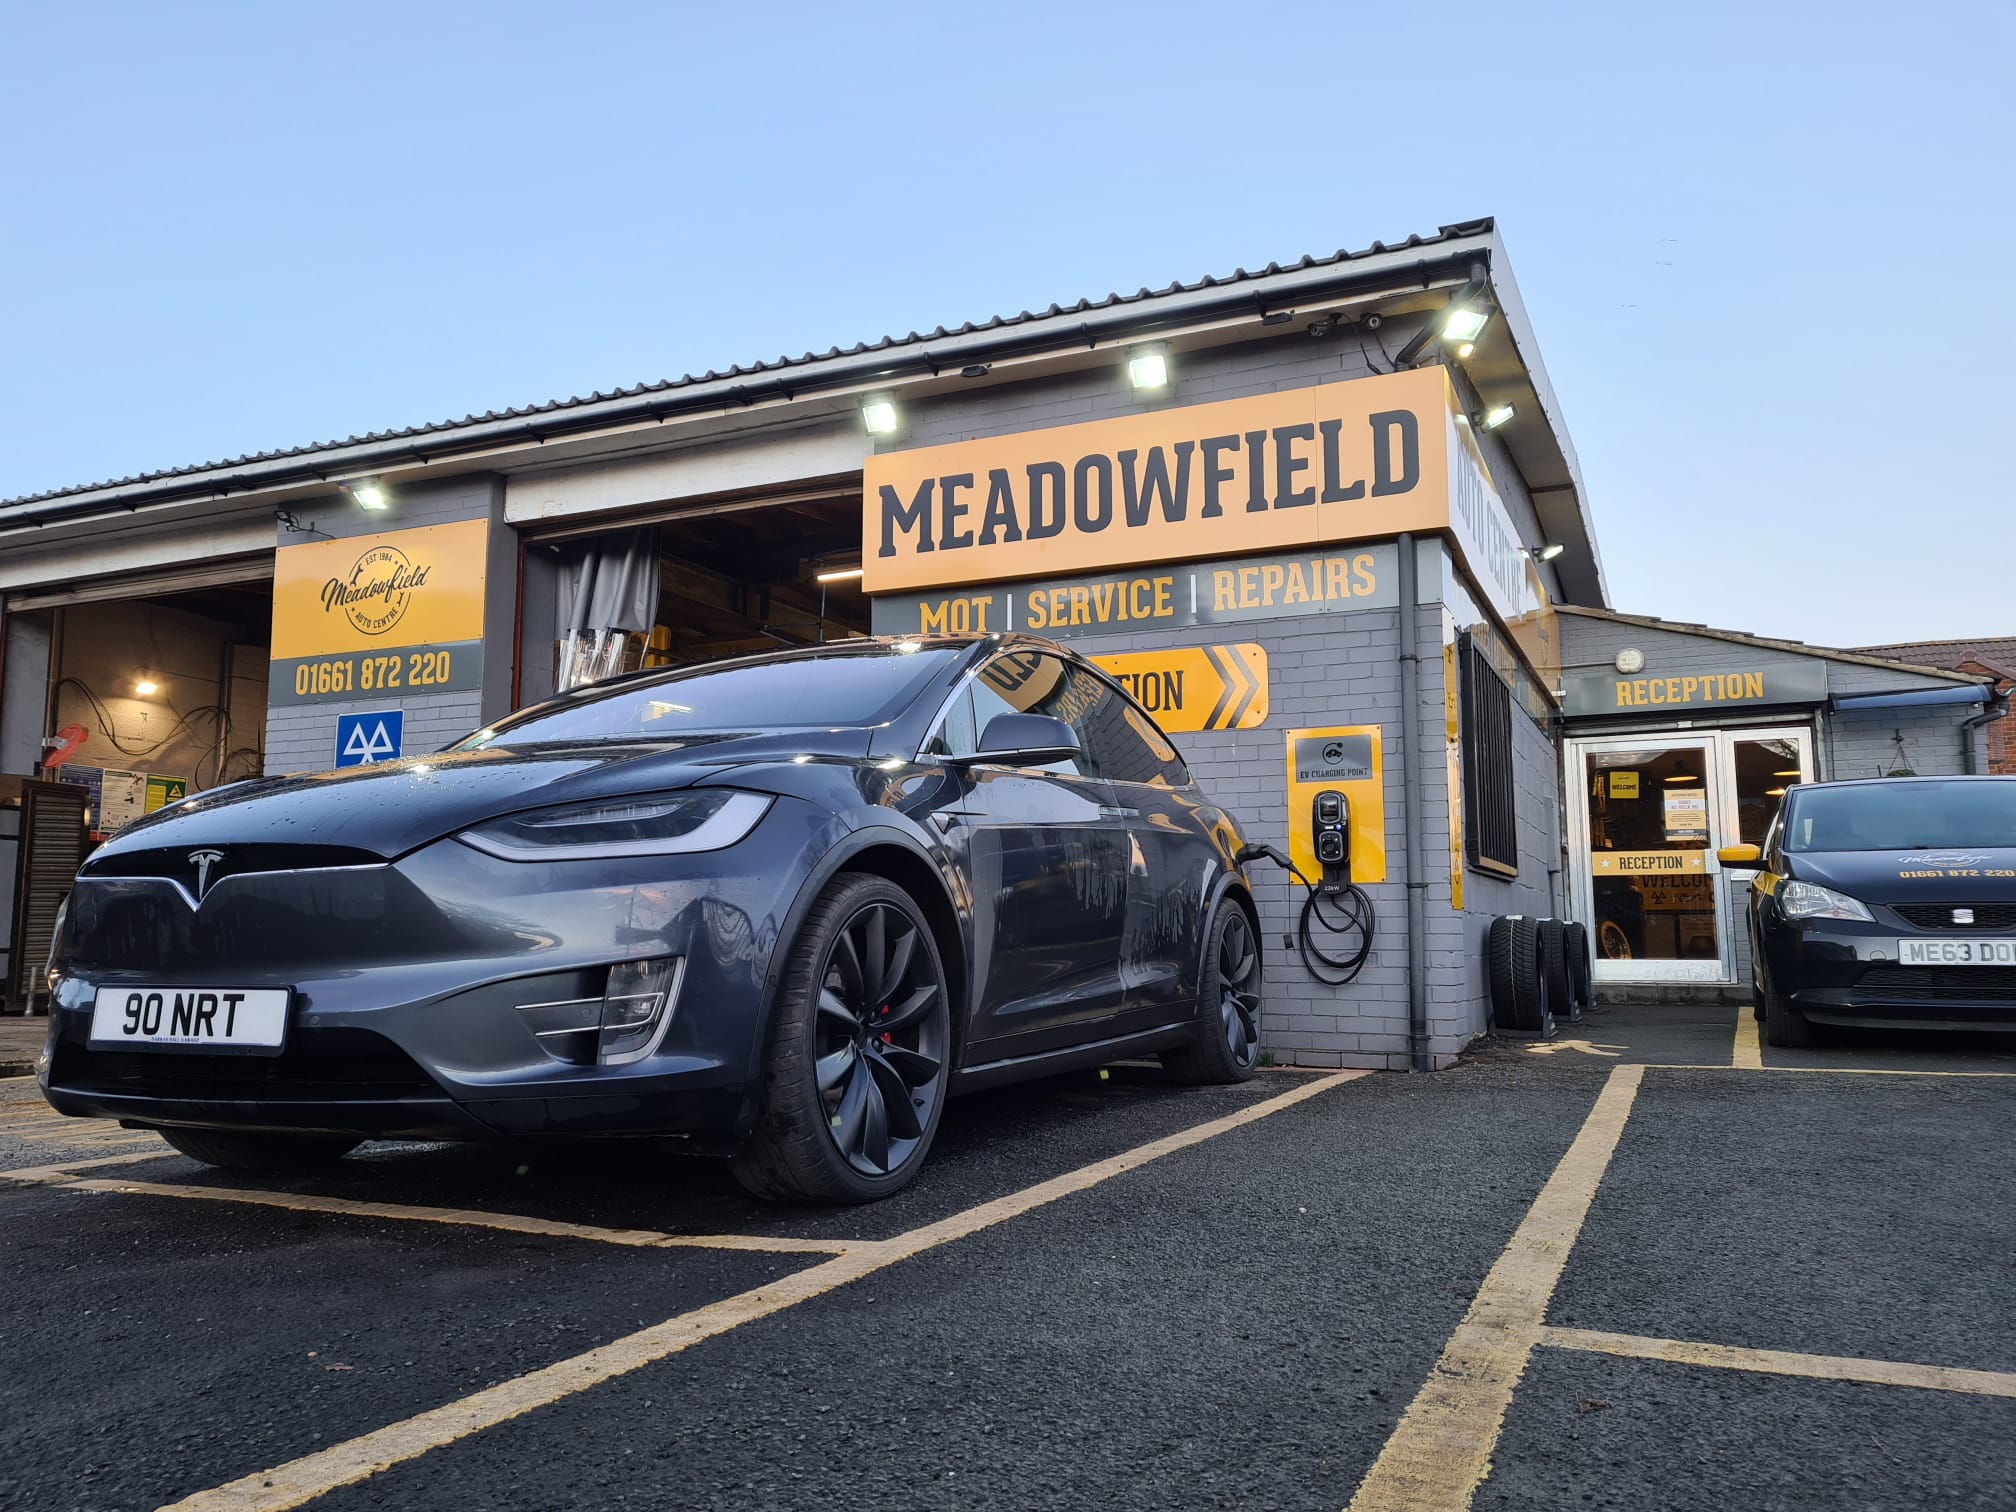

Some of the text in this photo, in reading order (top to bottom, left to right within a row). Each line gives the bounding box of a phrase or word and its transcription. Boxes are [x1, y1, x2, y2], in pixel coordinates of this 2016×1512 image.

[878, 409, 1420, 558] MEADOWFIELD
[365, 552, 393, 566] EST 1984
[321, 564, 431, 613] Meadowfield
[919, 554, 1376, 634] MOT SERVICE REPAIRS
[355, 606, 399, 629] AUTO CENTRE
[295, 651, 450, 696] 01661 872 220
[1616, 672, 1764, 707] RECEPTION
[1300, 767, 1368, 779] EV CHARGING POINT
[1619, 855, 1683, 870] RECEPTION
[1899, 869, 2016, 879] 01661 872 220
[1909, 943, 1973, 962] ME63
[122, 992, 245, 1037] 90 NRT
